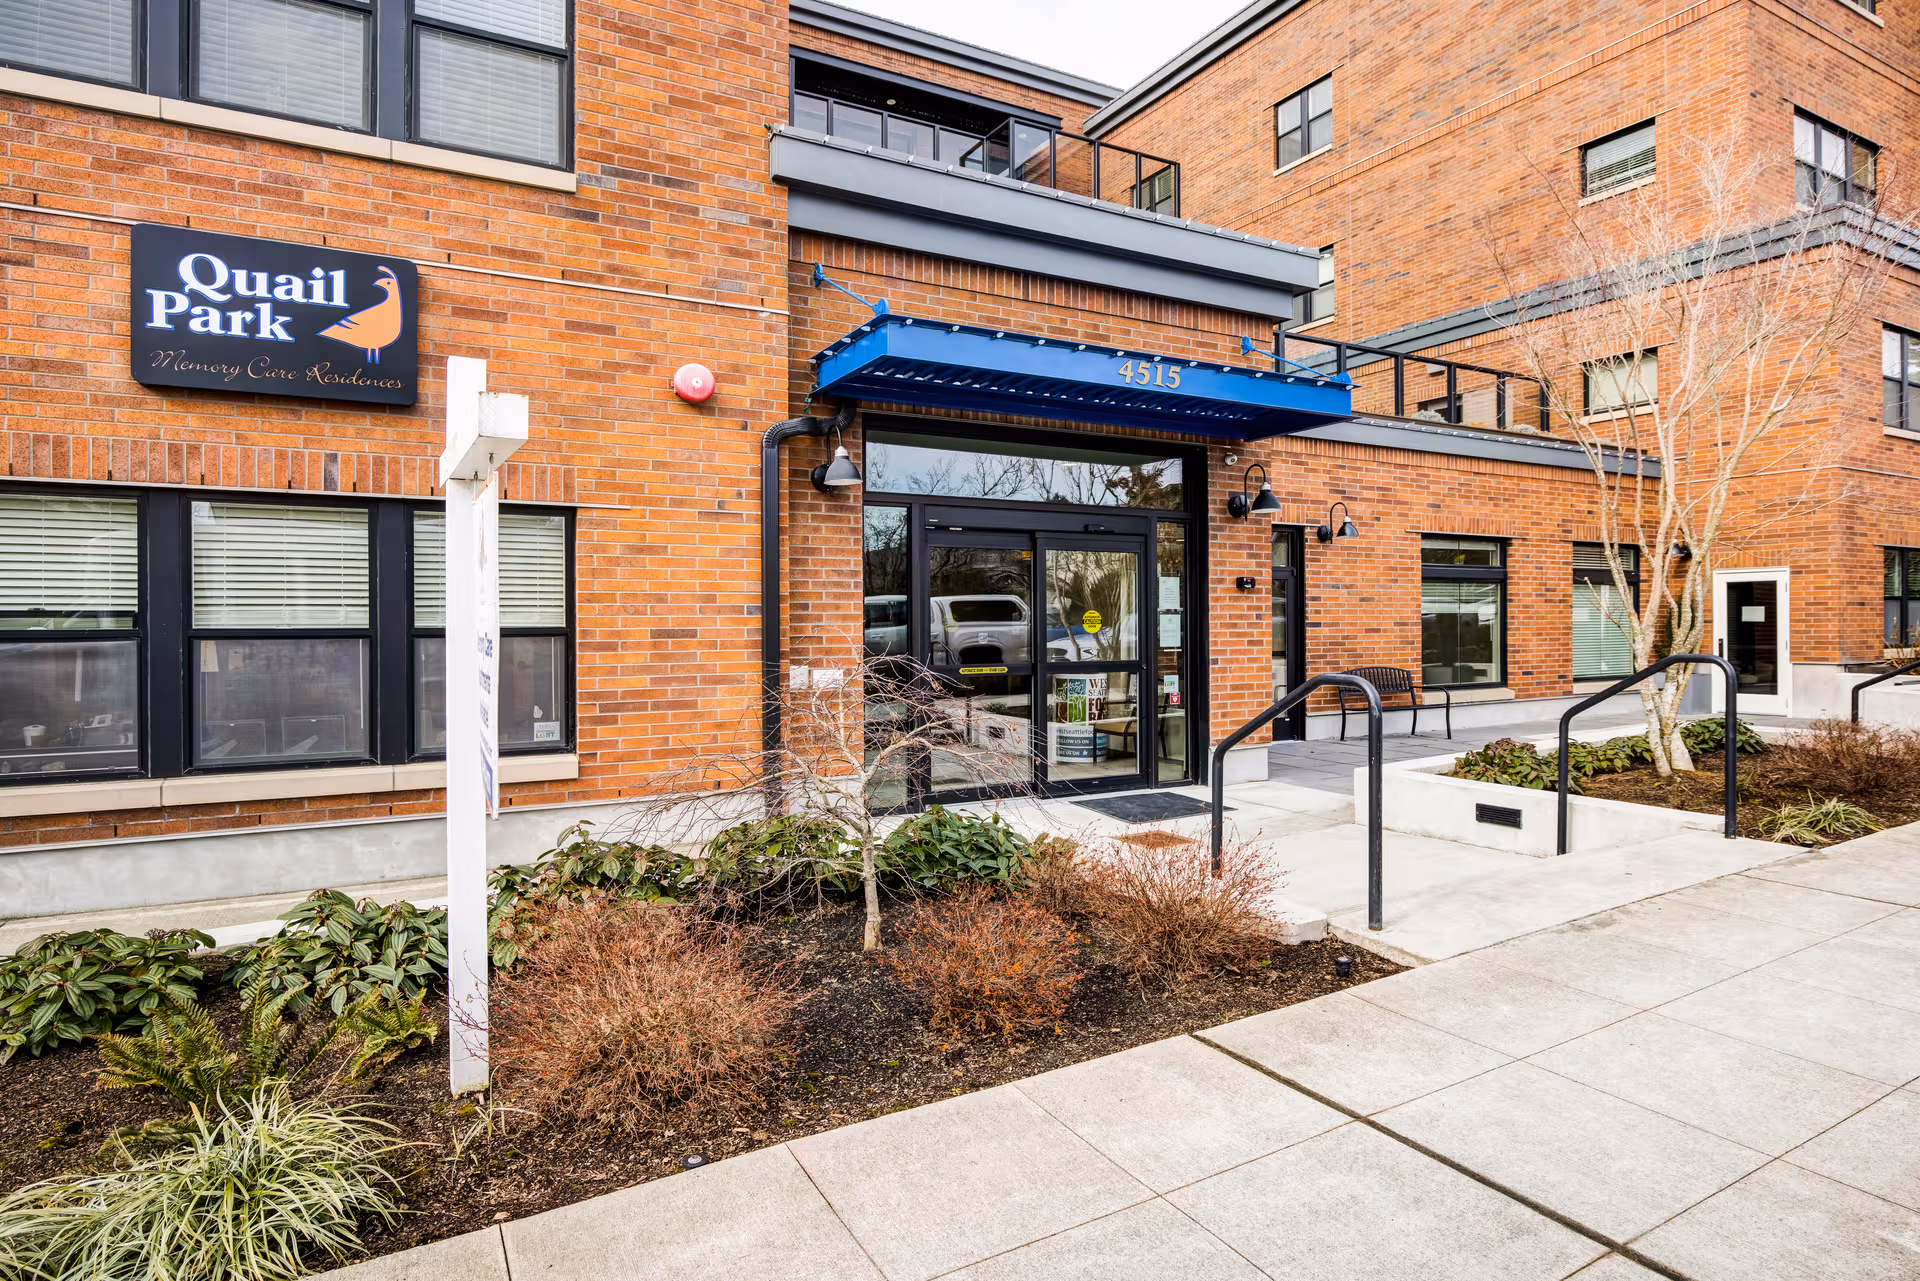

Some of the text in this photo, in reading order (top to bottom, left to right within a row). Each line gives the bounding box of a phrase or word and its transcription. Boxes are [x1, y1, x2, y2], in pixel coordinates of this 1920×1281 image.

[178, 252, 350, 308] Quail
[145, 289, 295, 342] Park
[149, 349, 406, 389] Memory Care Residences
[1118, 360, 1181, 389] 4515
[1089, 679, 1107, 688] WES
